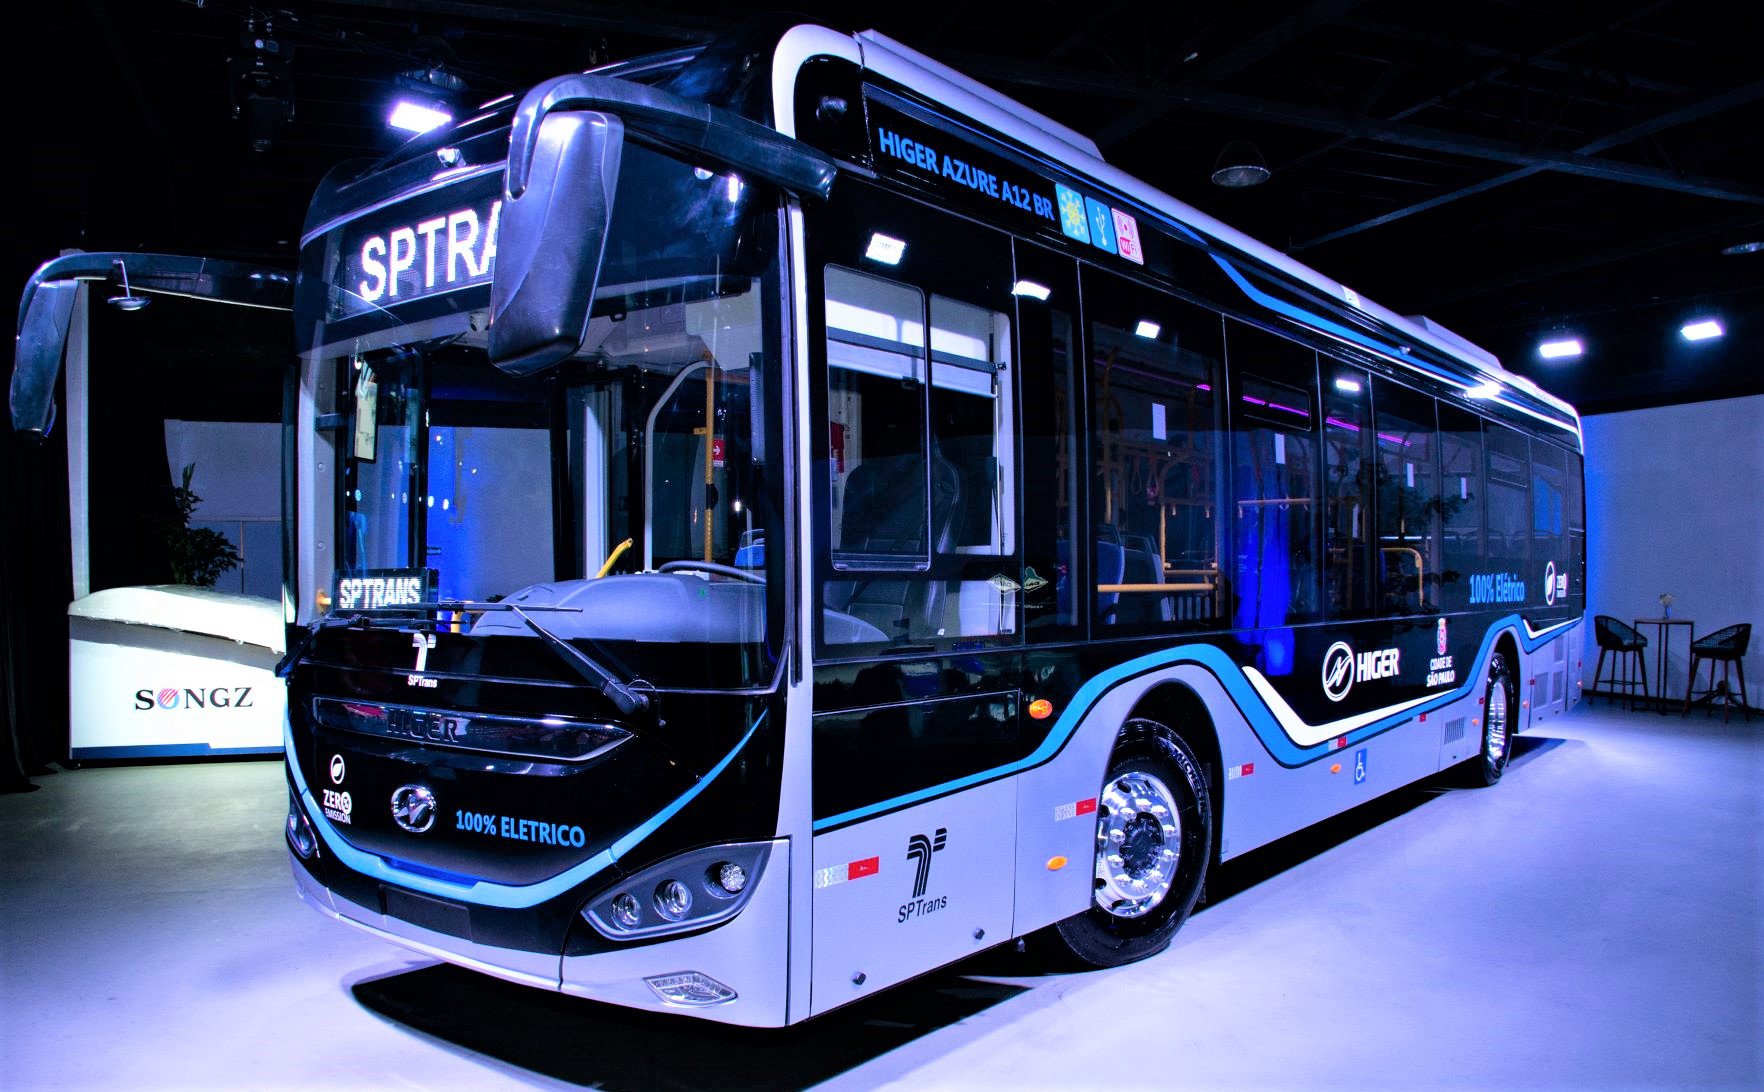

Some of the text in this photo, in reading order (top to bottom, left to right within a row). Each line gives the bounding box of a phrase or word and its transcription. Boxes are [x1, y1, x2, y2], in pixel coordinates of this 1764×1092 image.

[878, 127, 1055, 221] HIGER AZURE A12 BR
[340, 578, 421, 609] SPTRANS
[1469, 573, 1525, 604] 100% Elétrico
[1356, 648, 1400, 682] HIGER
[407, 674, 438, 689] SPTrans
[135, 686, 253, 711] SONGZ
[456, 809, 586, 848] 100% ELETRICO
[898, 895, 948, 924] SPTrans
